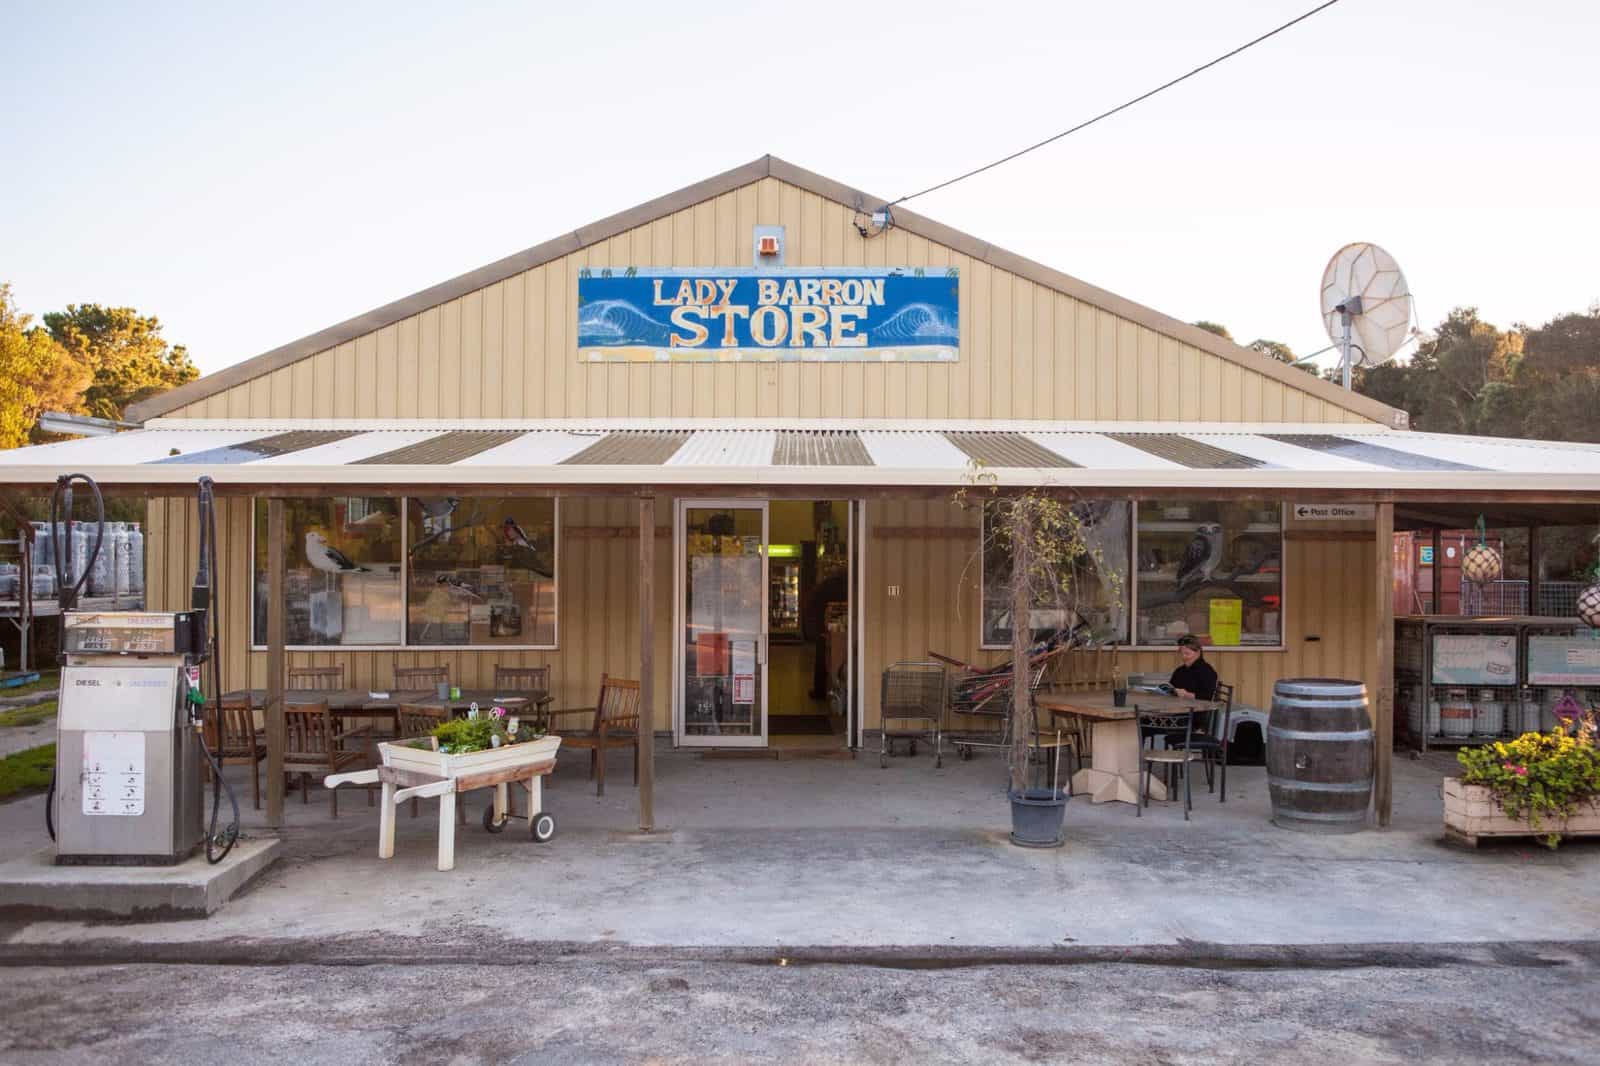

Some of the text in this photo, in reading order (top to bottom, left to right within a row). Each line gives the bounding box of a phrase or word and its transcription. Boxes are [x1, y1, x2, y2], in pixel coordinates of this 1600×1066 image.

[654, 280, 885, 306] LADY BARRON
[671, 305, 868, 347] STORE
[1311, 508, 1355, 516] Post Office
[75, 679, 101, 687] DIESEL
